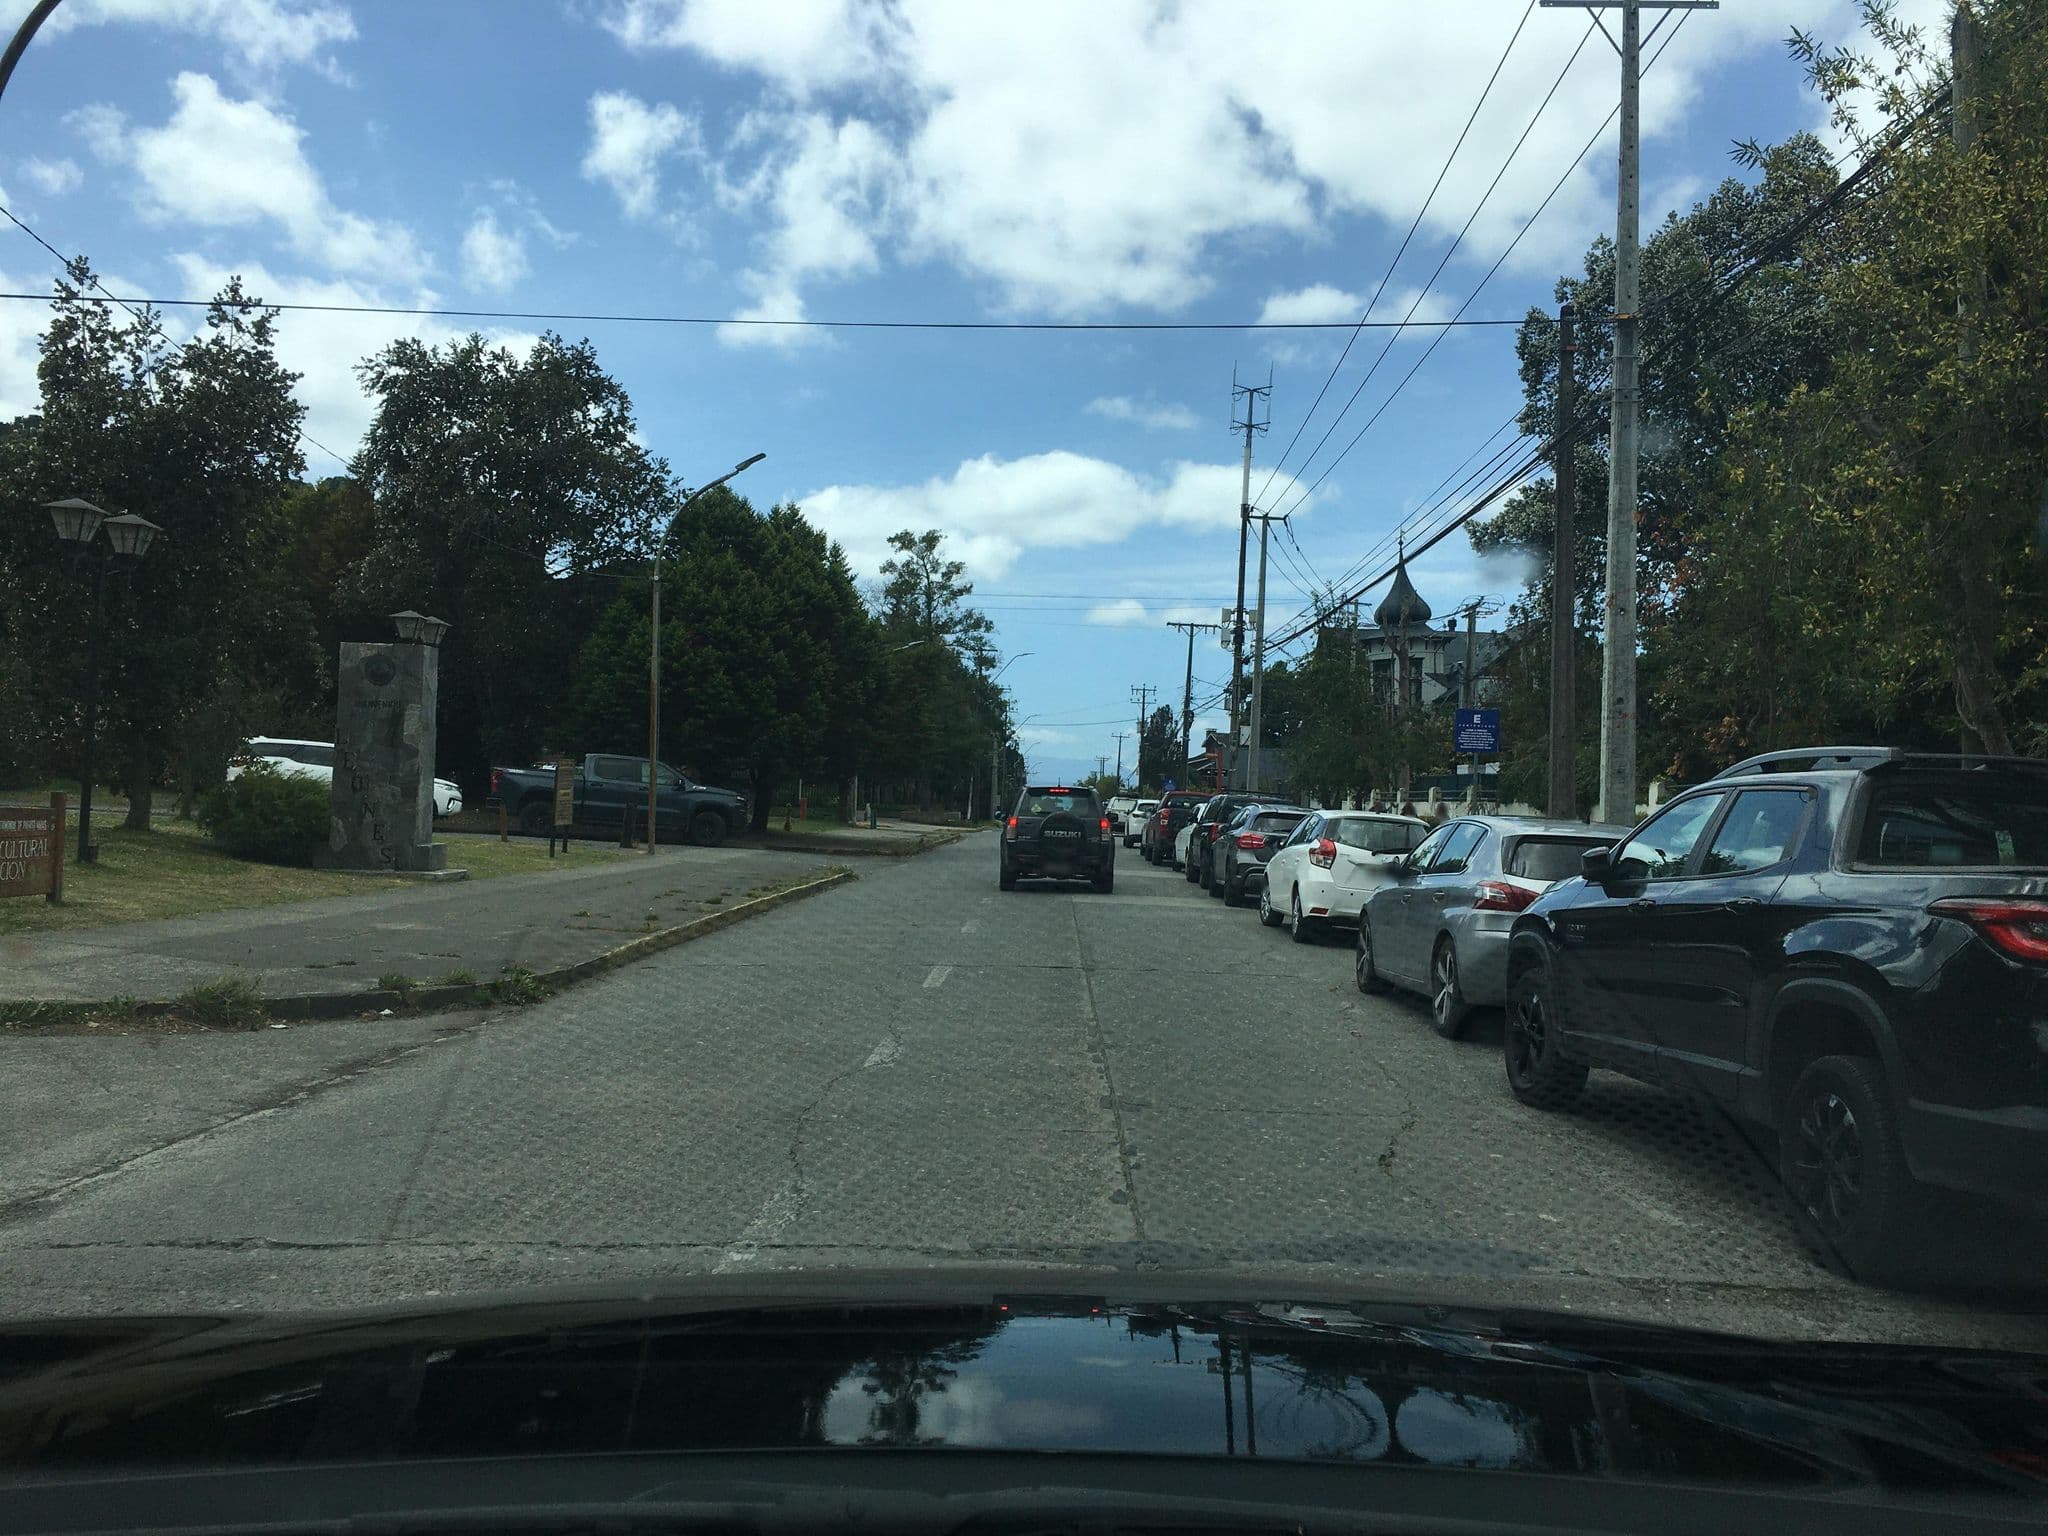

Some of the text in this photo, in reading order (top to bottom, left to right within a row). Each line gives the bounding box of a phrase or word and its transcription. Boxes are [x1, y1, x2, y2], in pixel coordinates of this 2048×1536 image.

[1474, 714, 1481, 723] E
[1043, 830, 1081, 838] SUZUKI
[0, 838, 49, 858] CULTURAL
